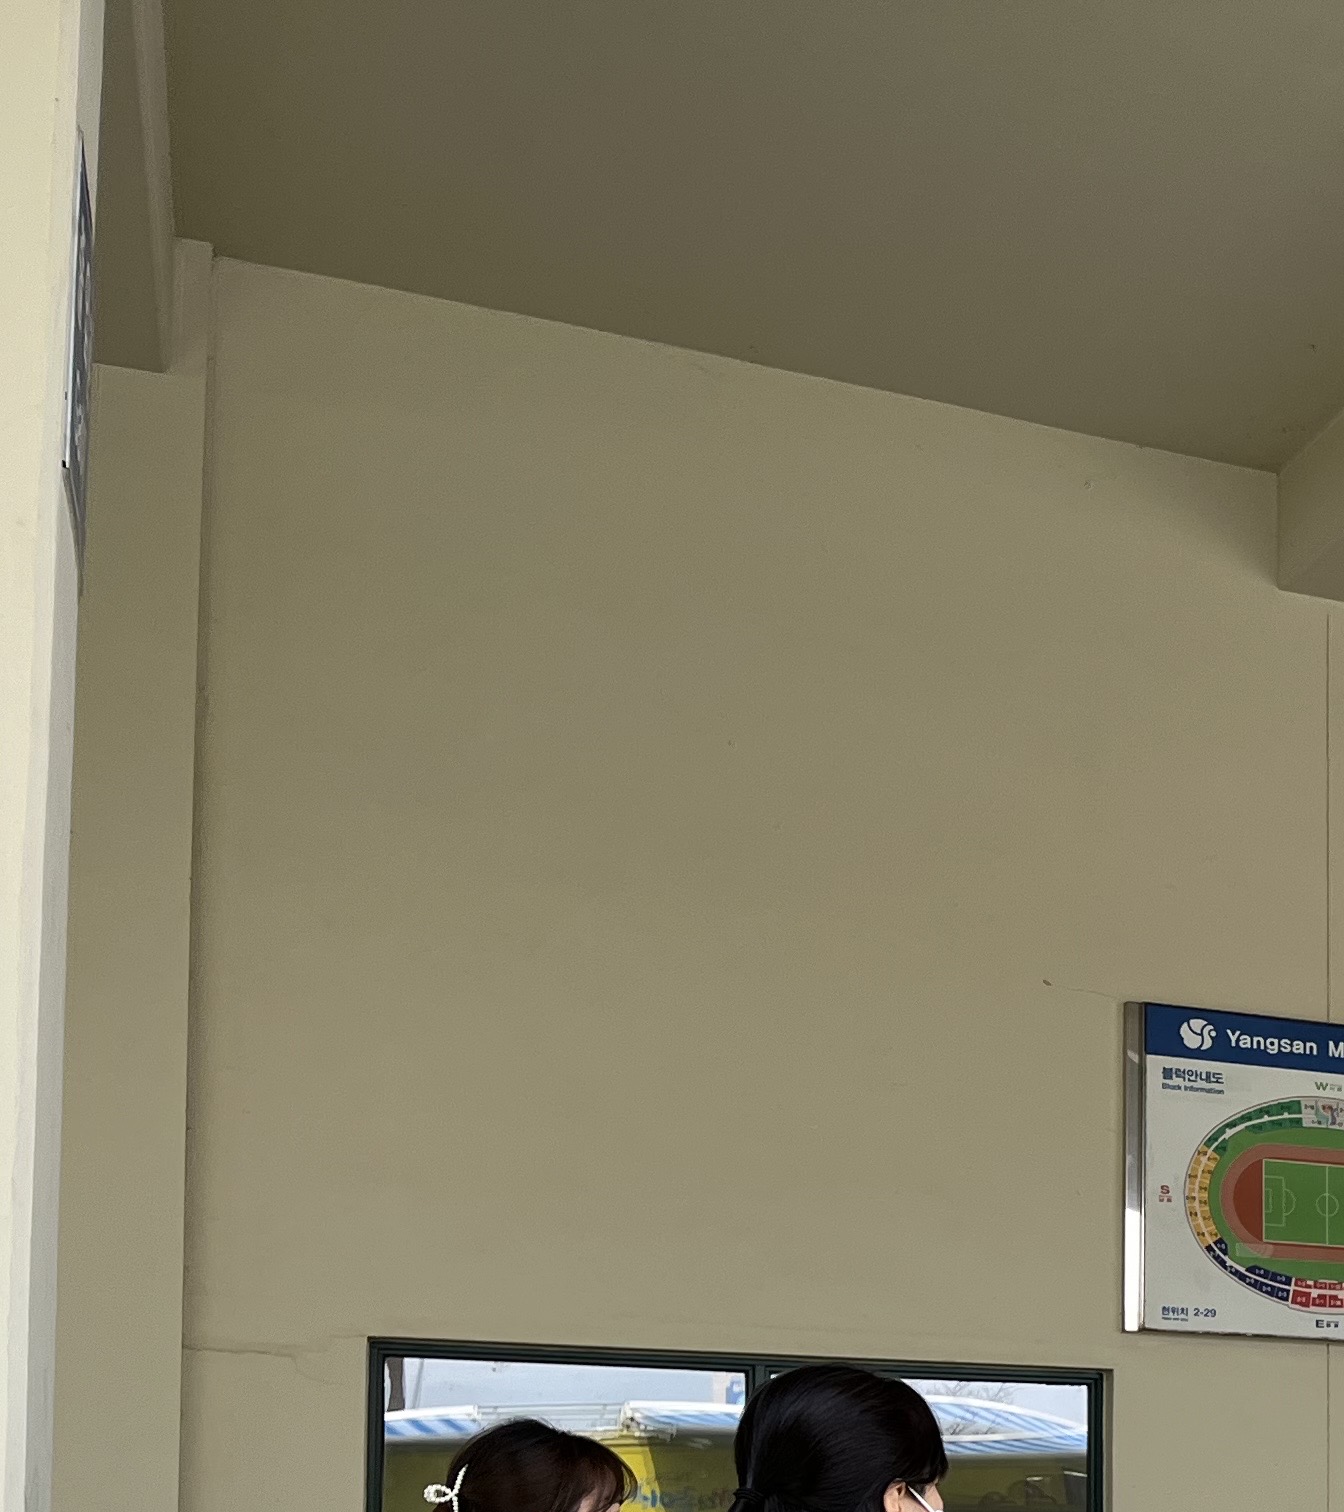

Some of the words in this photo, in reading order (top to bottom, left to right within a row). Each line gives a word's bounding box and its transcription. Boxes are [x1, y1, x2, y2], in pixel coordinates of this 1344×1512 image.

[1226, 1028, 1318, 1056] Yangsan
[1315, 1081, 1329, 1091] W
[1160, 1184, 1171, 1195] S
